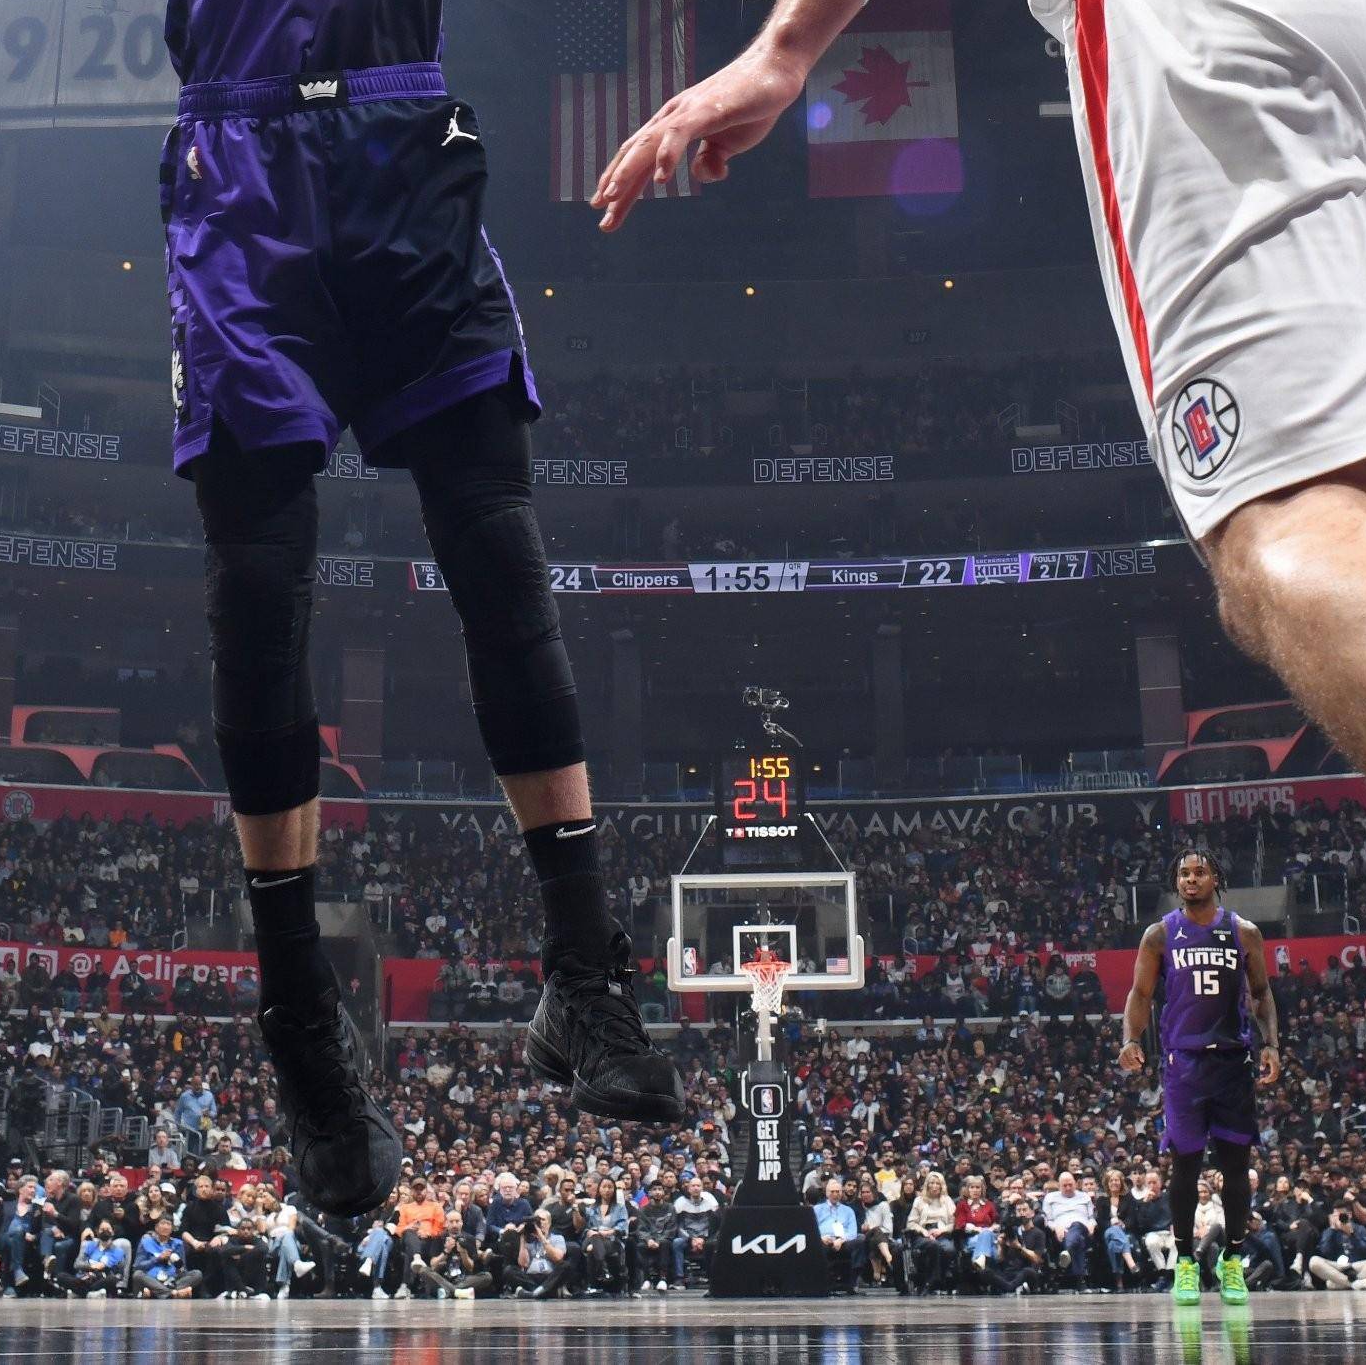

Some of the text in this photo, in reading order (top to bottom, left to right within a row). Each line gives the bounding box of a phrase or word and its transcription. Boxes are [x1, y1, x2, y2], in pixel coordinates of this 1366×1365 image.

[72, 13, 169, 82] 20
[752, 456, 896, 483] DEFENSE
[788, 561, 802, 570] QTR
[1034, 554, 1057, 564] FOULS
[1065, 553, 1079, 562] TOL
[425, 573, 436, 588] 5
[549, 565, 772, 593] 24 Clippers 1:55
[831, 561, 952, 587] Kings 22
[974, 562, 1020, 578] KINGS
[1040, 564, 1050, 579] 2
[1068, 563, 1077, 578] 7
[791, 572, 800, 591] 1
[750, 757, 790, 779] 1:55
[734, 780, 787, 820] 24
[745, 825, 798, 838] TISSOT
[1171, 948, 1238, 971] KINGS
[1192, 970, 1220, 995] 15
[756, 1119, 780, 1141] GET
[757, 1140, 781, 1161] THE
[757, 1160, 782, 1182] APP
[731, 1233, 807, 1255] KIA
